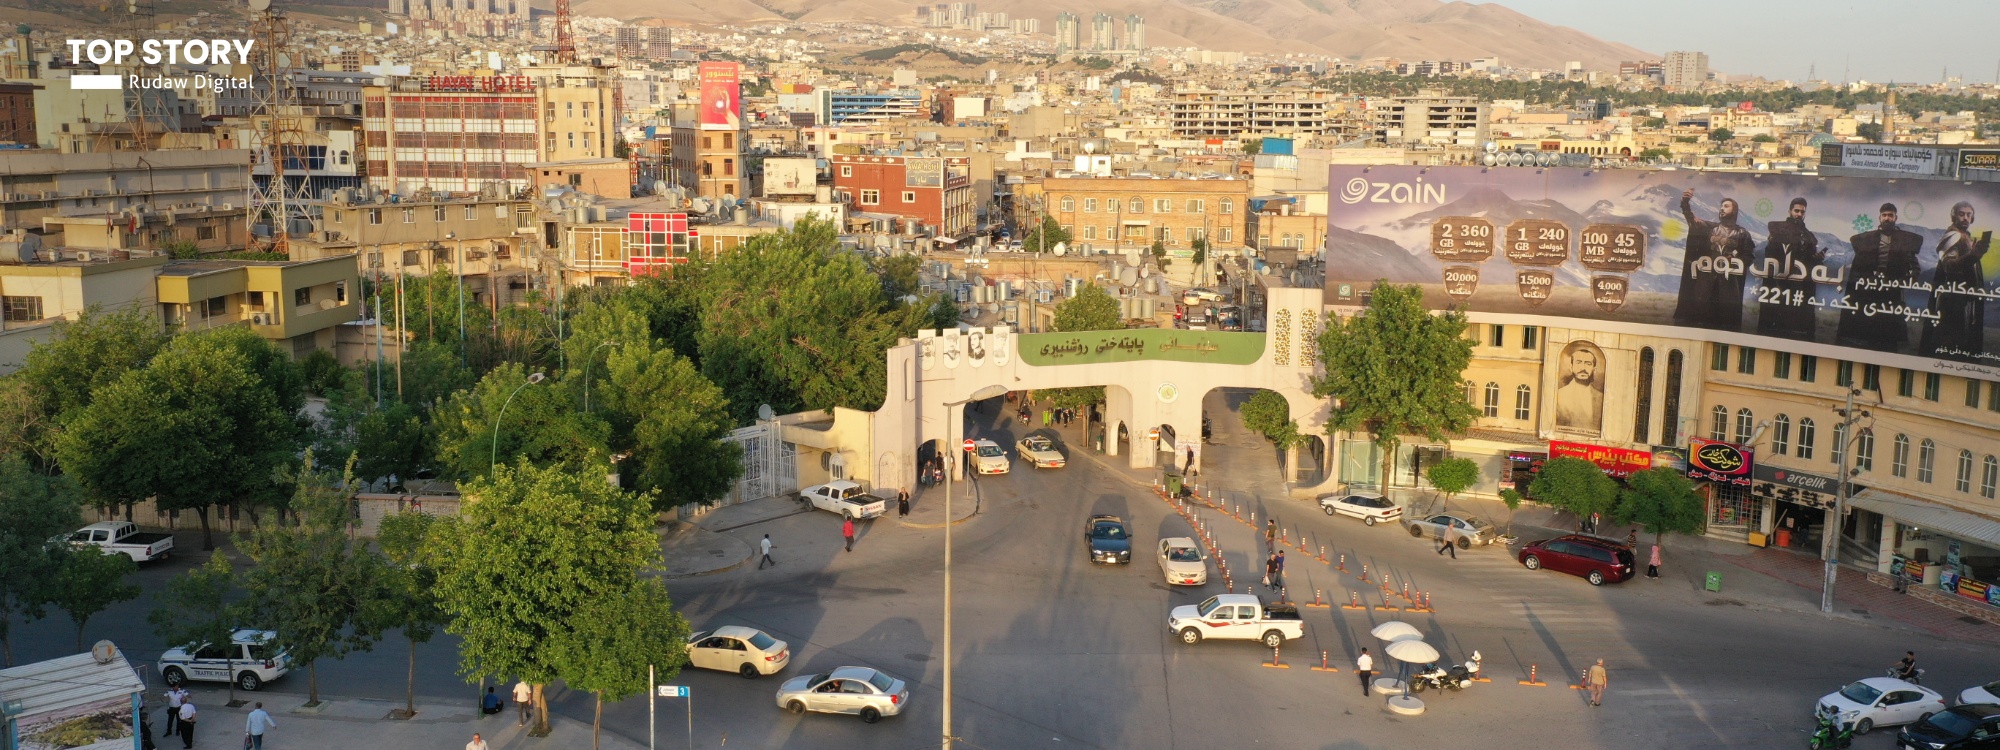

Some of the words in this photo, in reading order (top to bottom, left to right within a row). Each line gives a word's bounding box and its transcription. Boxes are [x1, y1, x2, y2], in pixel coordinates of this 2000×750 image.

[429, 75, 475, 90] HAYAT
[481, 75, 536, 92] HOTEL
[1851, 159, 1864, 167] Swara
[1898, 162, 1920, 172] Company
[1964, 154, 1997, 164] SWARA
[1370, 177, 1445, 204] zain
[1442, 224, 1453, 238] 2
[1460, 225, 1489, 237] 360
[1518, 228, 1528, 241] 1
[1538, 228, 1565, 240] 240
[1440, 239, 1454, 248] GB
[1515, 242, 1530, 251] GB
[1583, 233, 1608, 245] 100
[1615, 234, 1635, 247] 45
[1586, 246, 1605, 256] MB
[1691, 244, 1744, 280] خۆم
[1446, 272, 1477, 282] 20,000
[1811, 264, 1846, 294] بە
[1597, 281, 1622, 291] 4,000
[1095, 336, 1144, 355] پایتەختی
[1787, 473, 1828, 489] arçelik
[194, 669, 214, 677] TRAFFIC
[680, 687, 685, 696] 3
